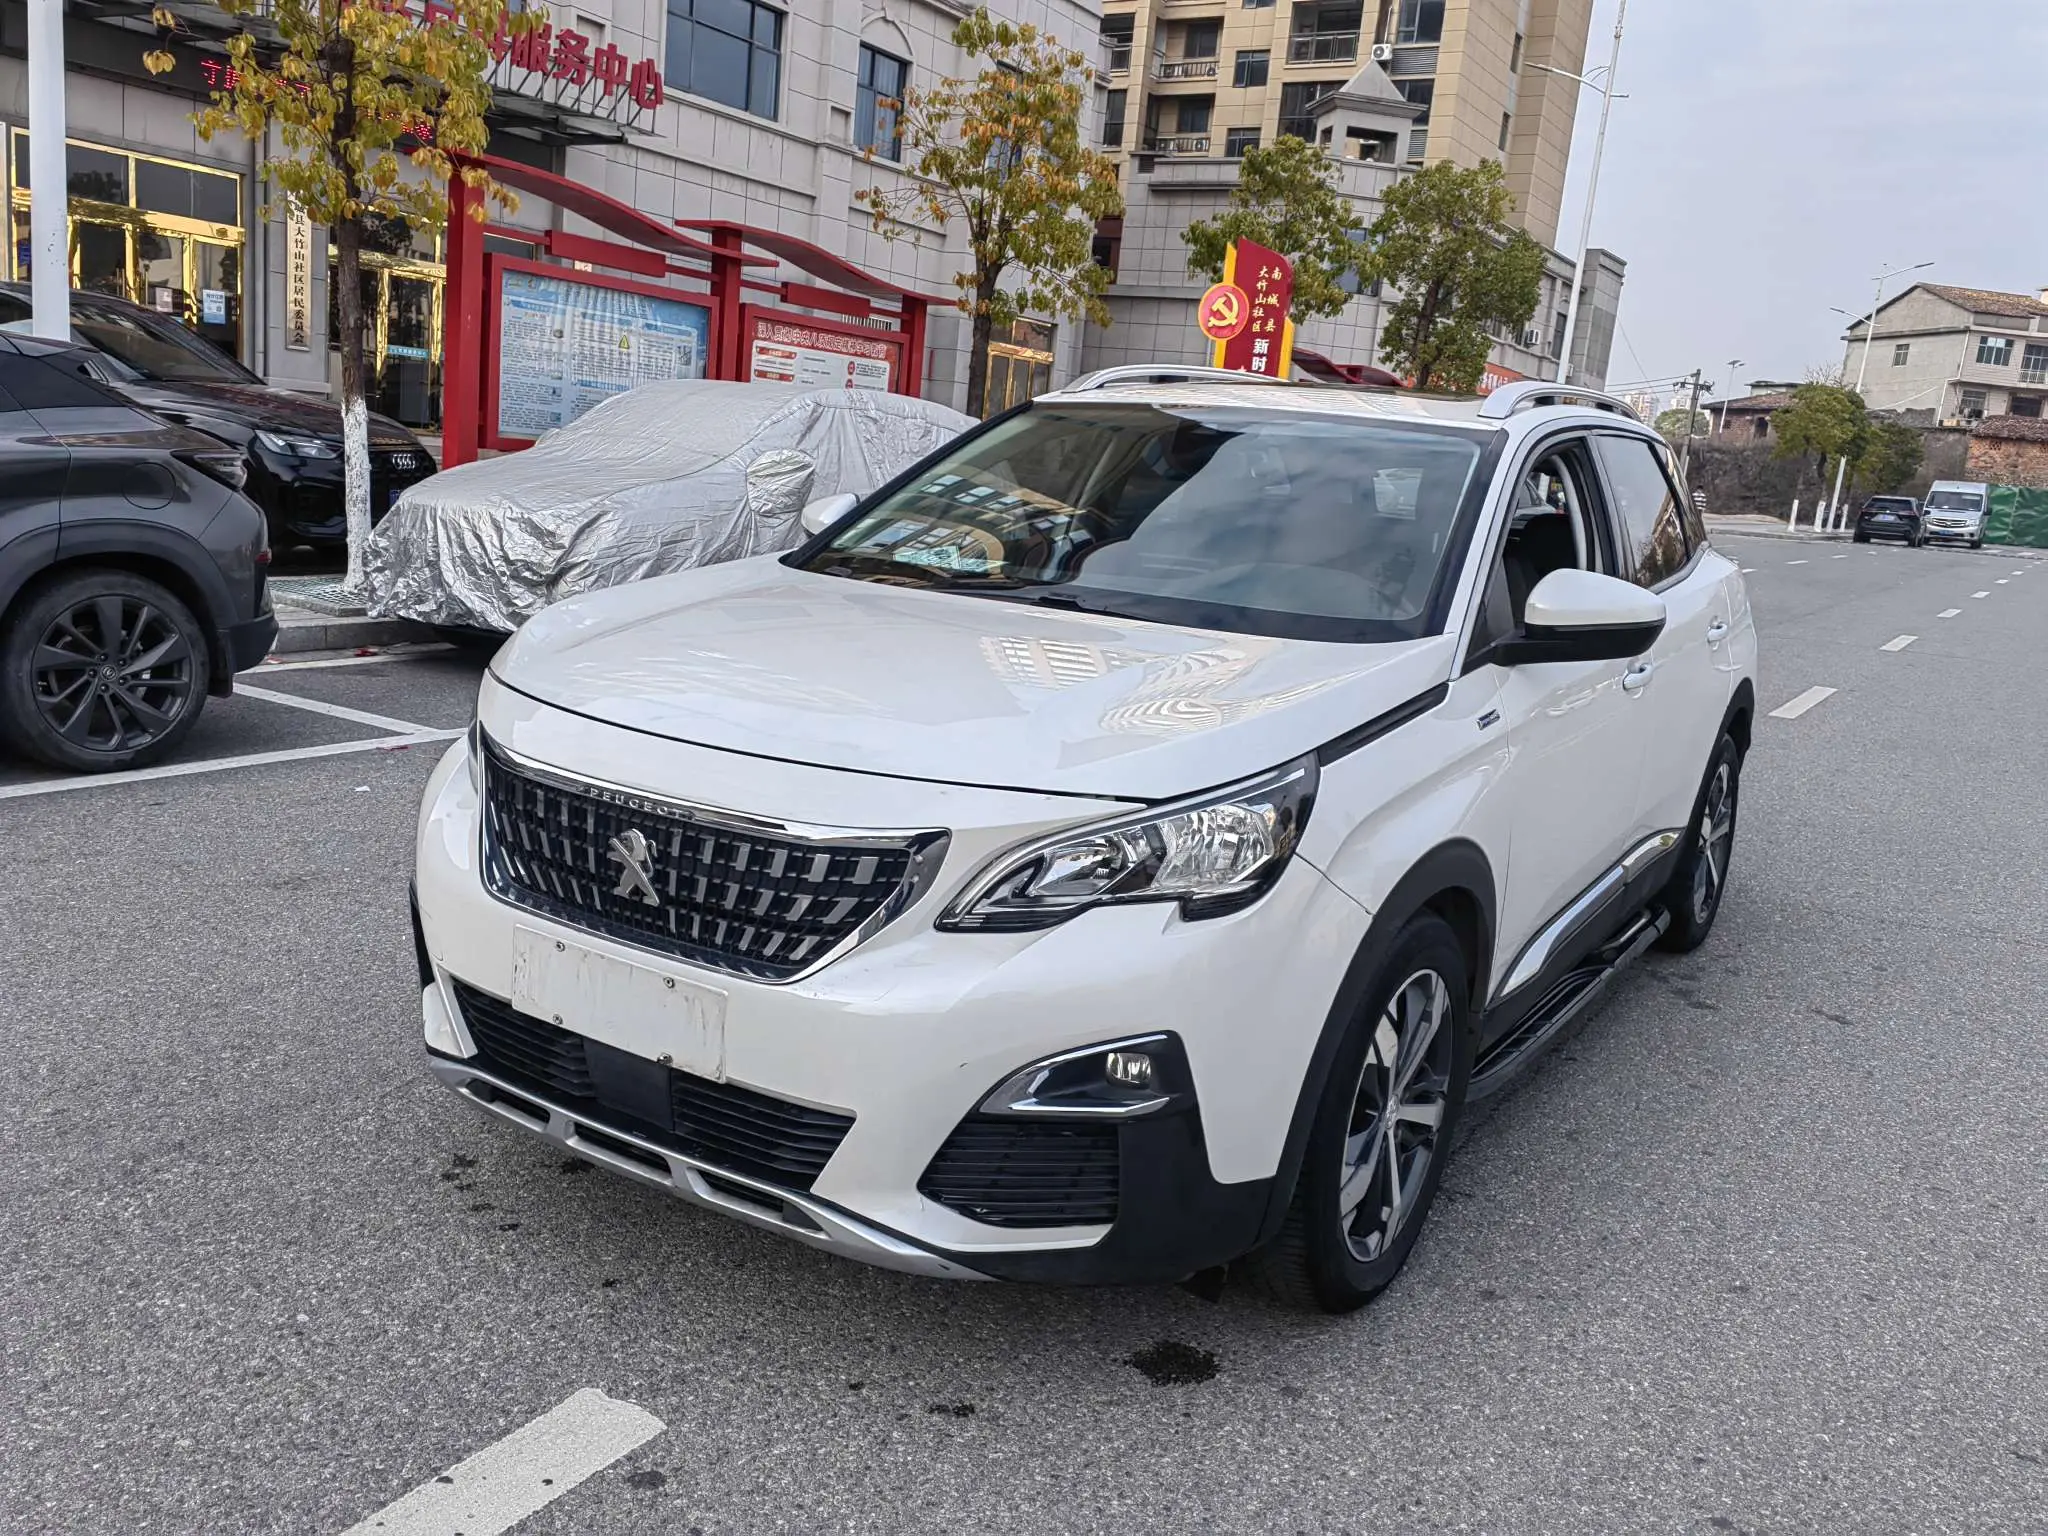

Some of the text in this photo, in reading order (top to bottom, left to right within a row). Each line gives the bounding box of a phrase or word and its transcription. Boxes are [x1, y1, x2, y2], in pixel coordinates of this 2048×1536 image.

[294, 196, 305, 343] 城县大竹山社区居民委员会
[1252, 265, 1269, 332] 大竹山社区
[1263, 266, 1282, 332] 南城县
[1251, 338, 1270, 372] 新时
[590, 787, 683, 818] PEUGEOT
